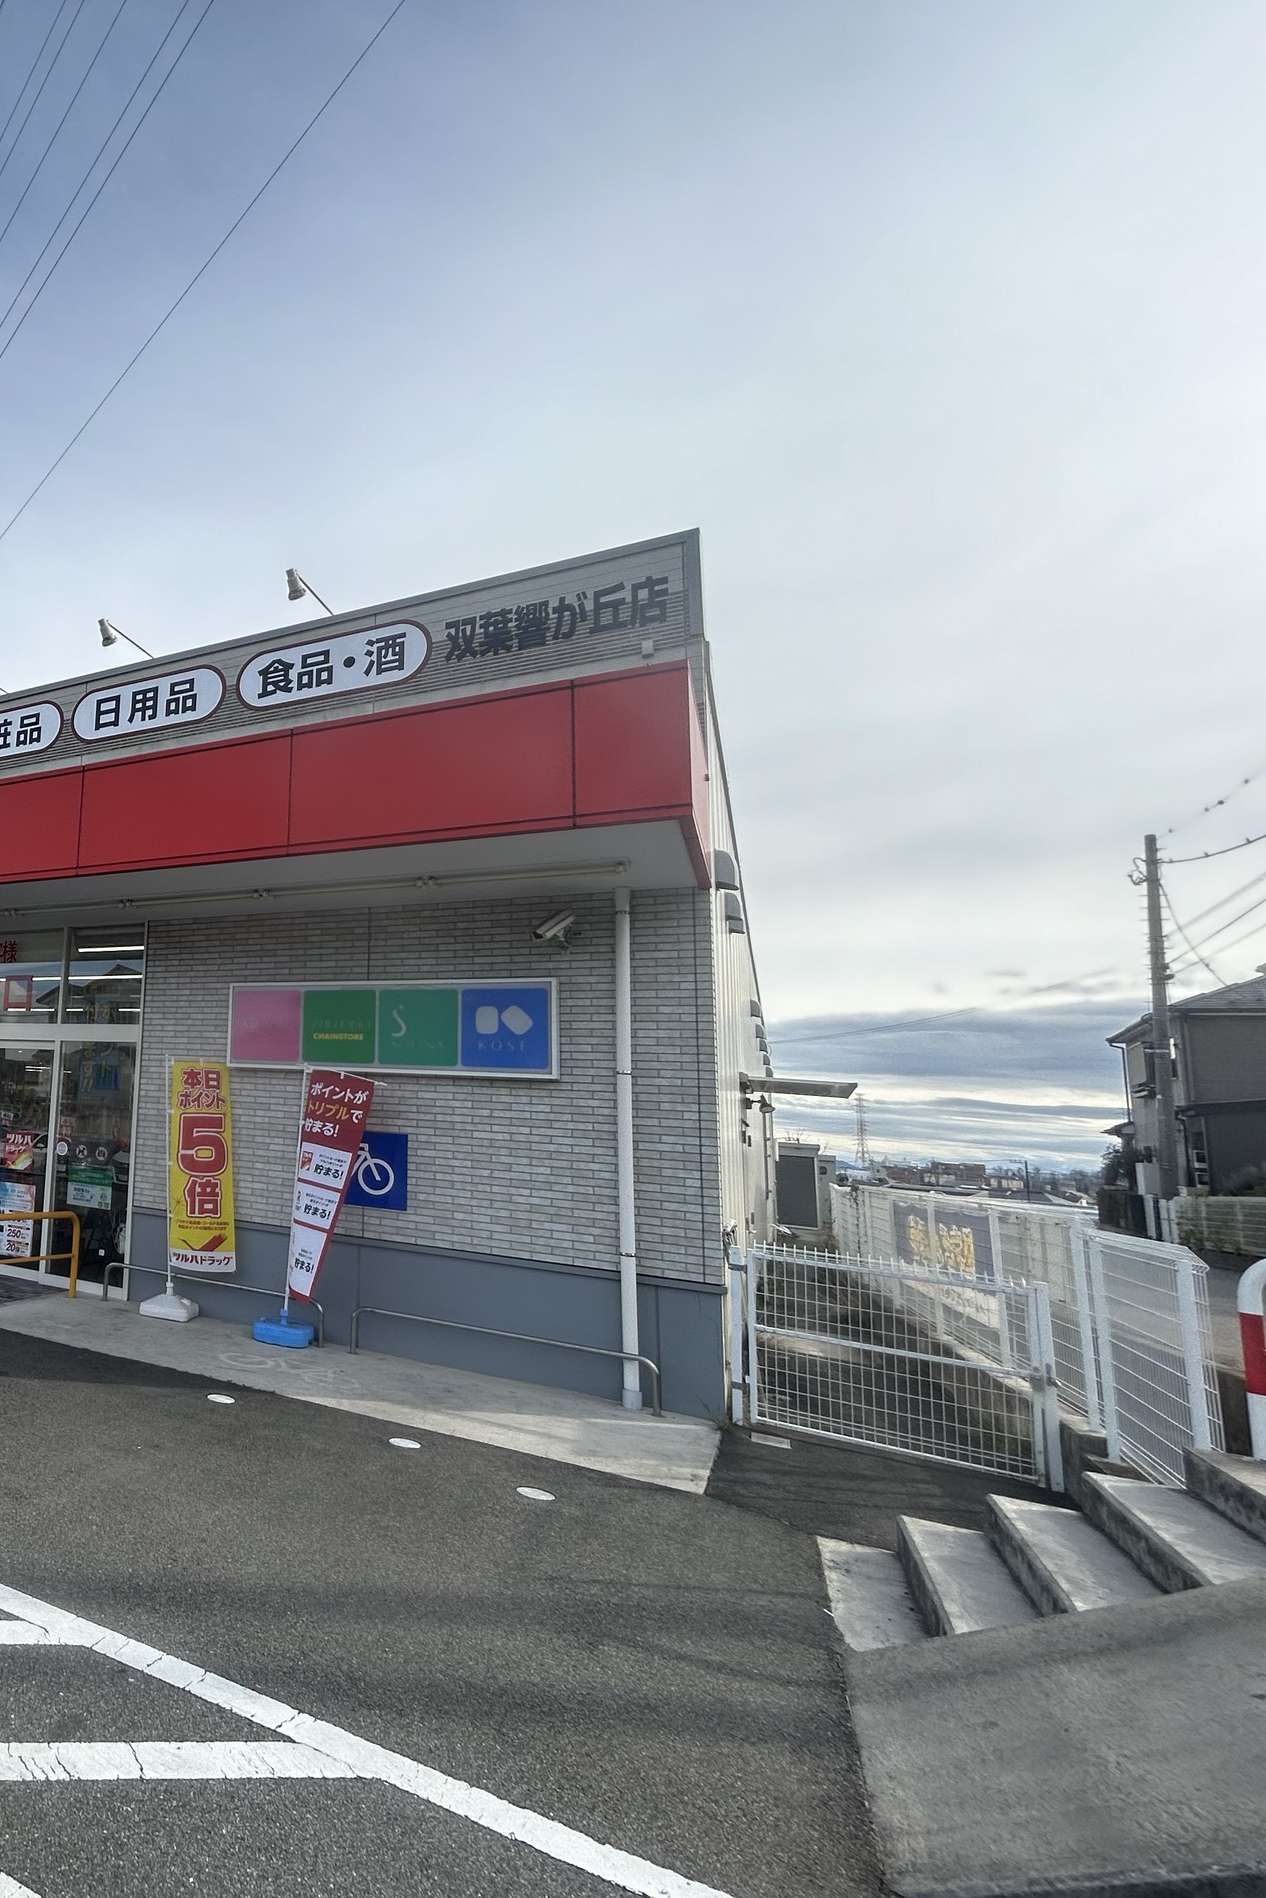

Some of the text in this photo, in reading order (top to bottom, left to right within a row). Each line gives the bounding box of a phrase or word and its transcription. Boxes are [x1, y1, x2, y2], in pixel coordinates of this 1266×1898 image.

[444, 575, 669, 664] 双葉響が丘店
[257, 631, 407, 700] 食品・酒
[94, 677, 198, 731] 日用品
[312, 1032, 365, 1041] CHAINSTORE
[182, 1067, 222, 1091] 本日
[178, 1090, 226, 1110] ポイント
[310, 1082, 370, 1104] ポイントが
[307, 1100, 364, 1123] トリプルで
[5, 1144, 26, 1153] ドラッグ
[6, 1133, 33, 1146] ツルハ
[177, 1112, 228, 1177] 5
[313, 1163, 344, 1180] 貯まる!
[184, 1177, 222, 1219] 倍
[303, 1203, 331, 1220] 貯まる!
[6, 1228, 22, 1239] 250
[172, 1251, 234, 1266] ツルハドラッグ
